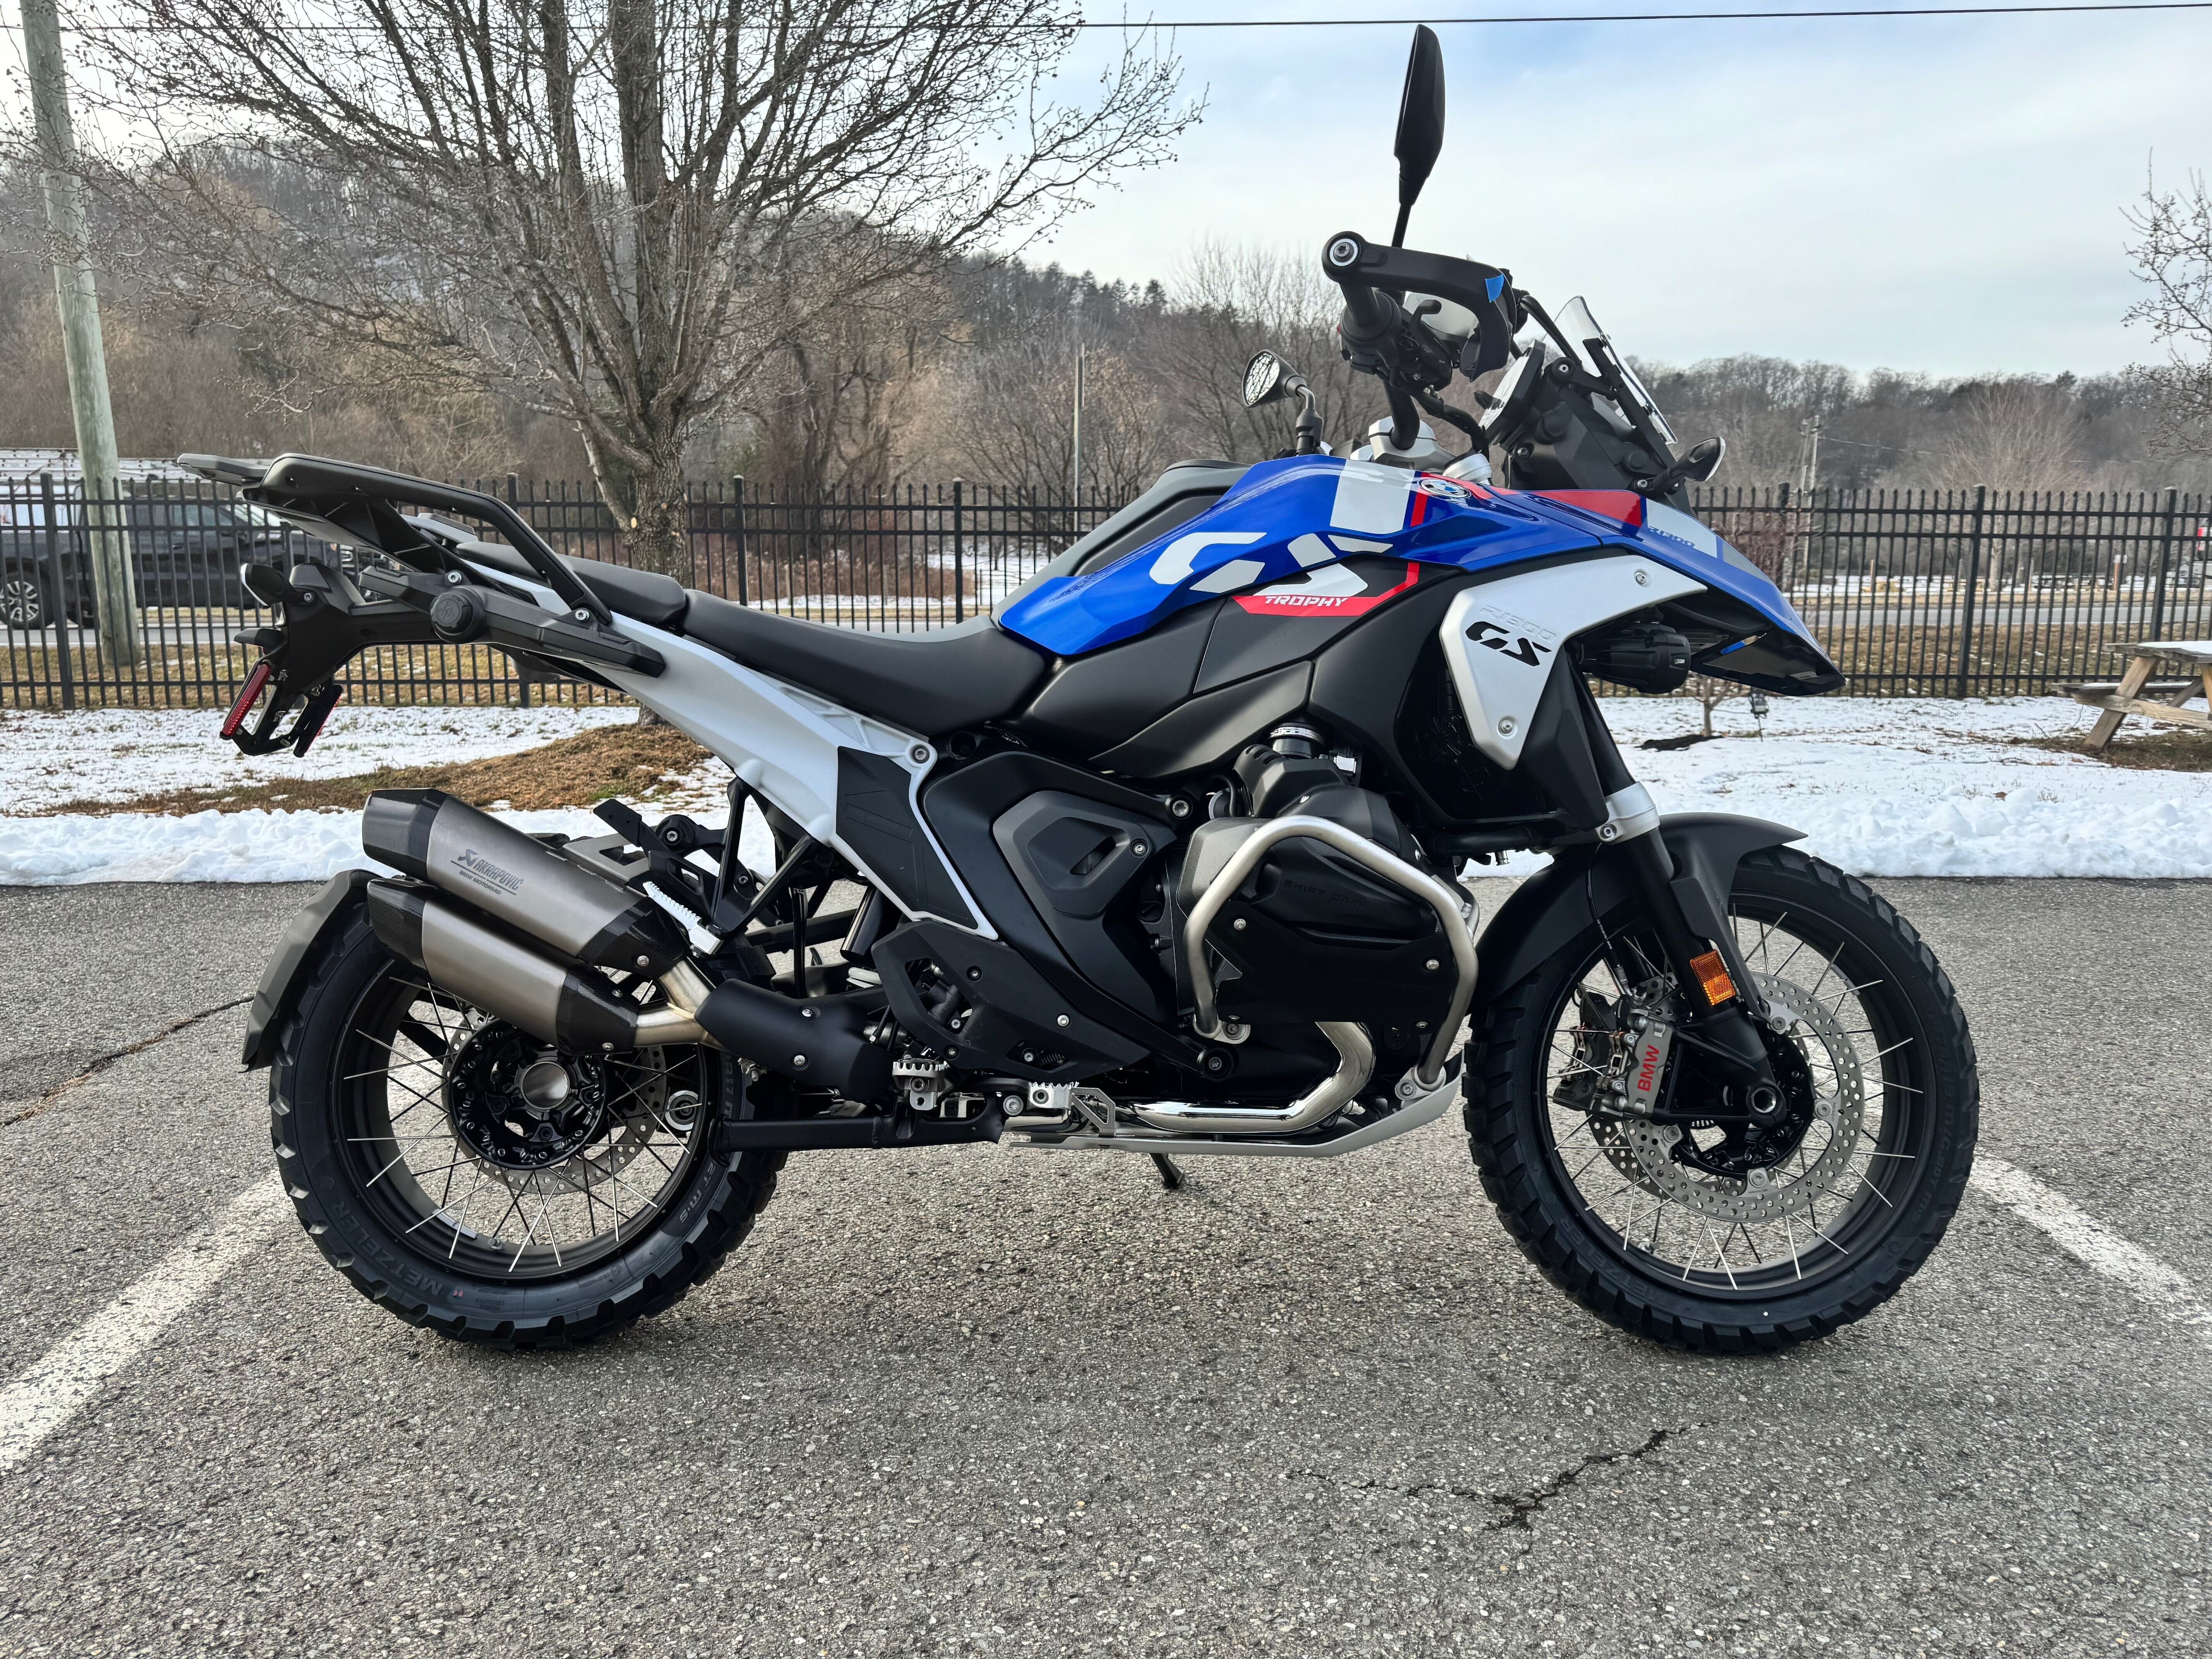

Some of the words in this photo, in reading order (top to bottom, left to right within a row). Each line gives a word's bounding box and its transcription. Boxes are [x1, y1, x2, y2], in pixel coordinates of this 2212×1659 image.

[1264, 596, 1349, 607] TROPHY
[1465, 621, 1552, 666] GS
[459, 870, 473, 880] BMW
[473, 878, 501, 895] MOTORRAD
[1637, 1044, 1660, 1092] BMW
[332, 1200, 443, 1296] METZELER
[1559, 1215, 1667, 1307] METZELER
